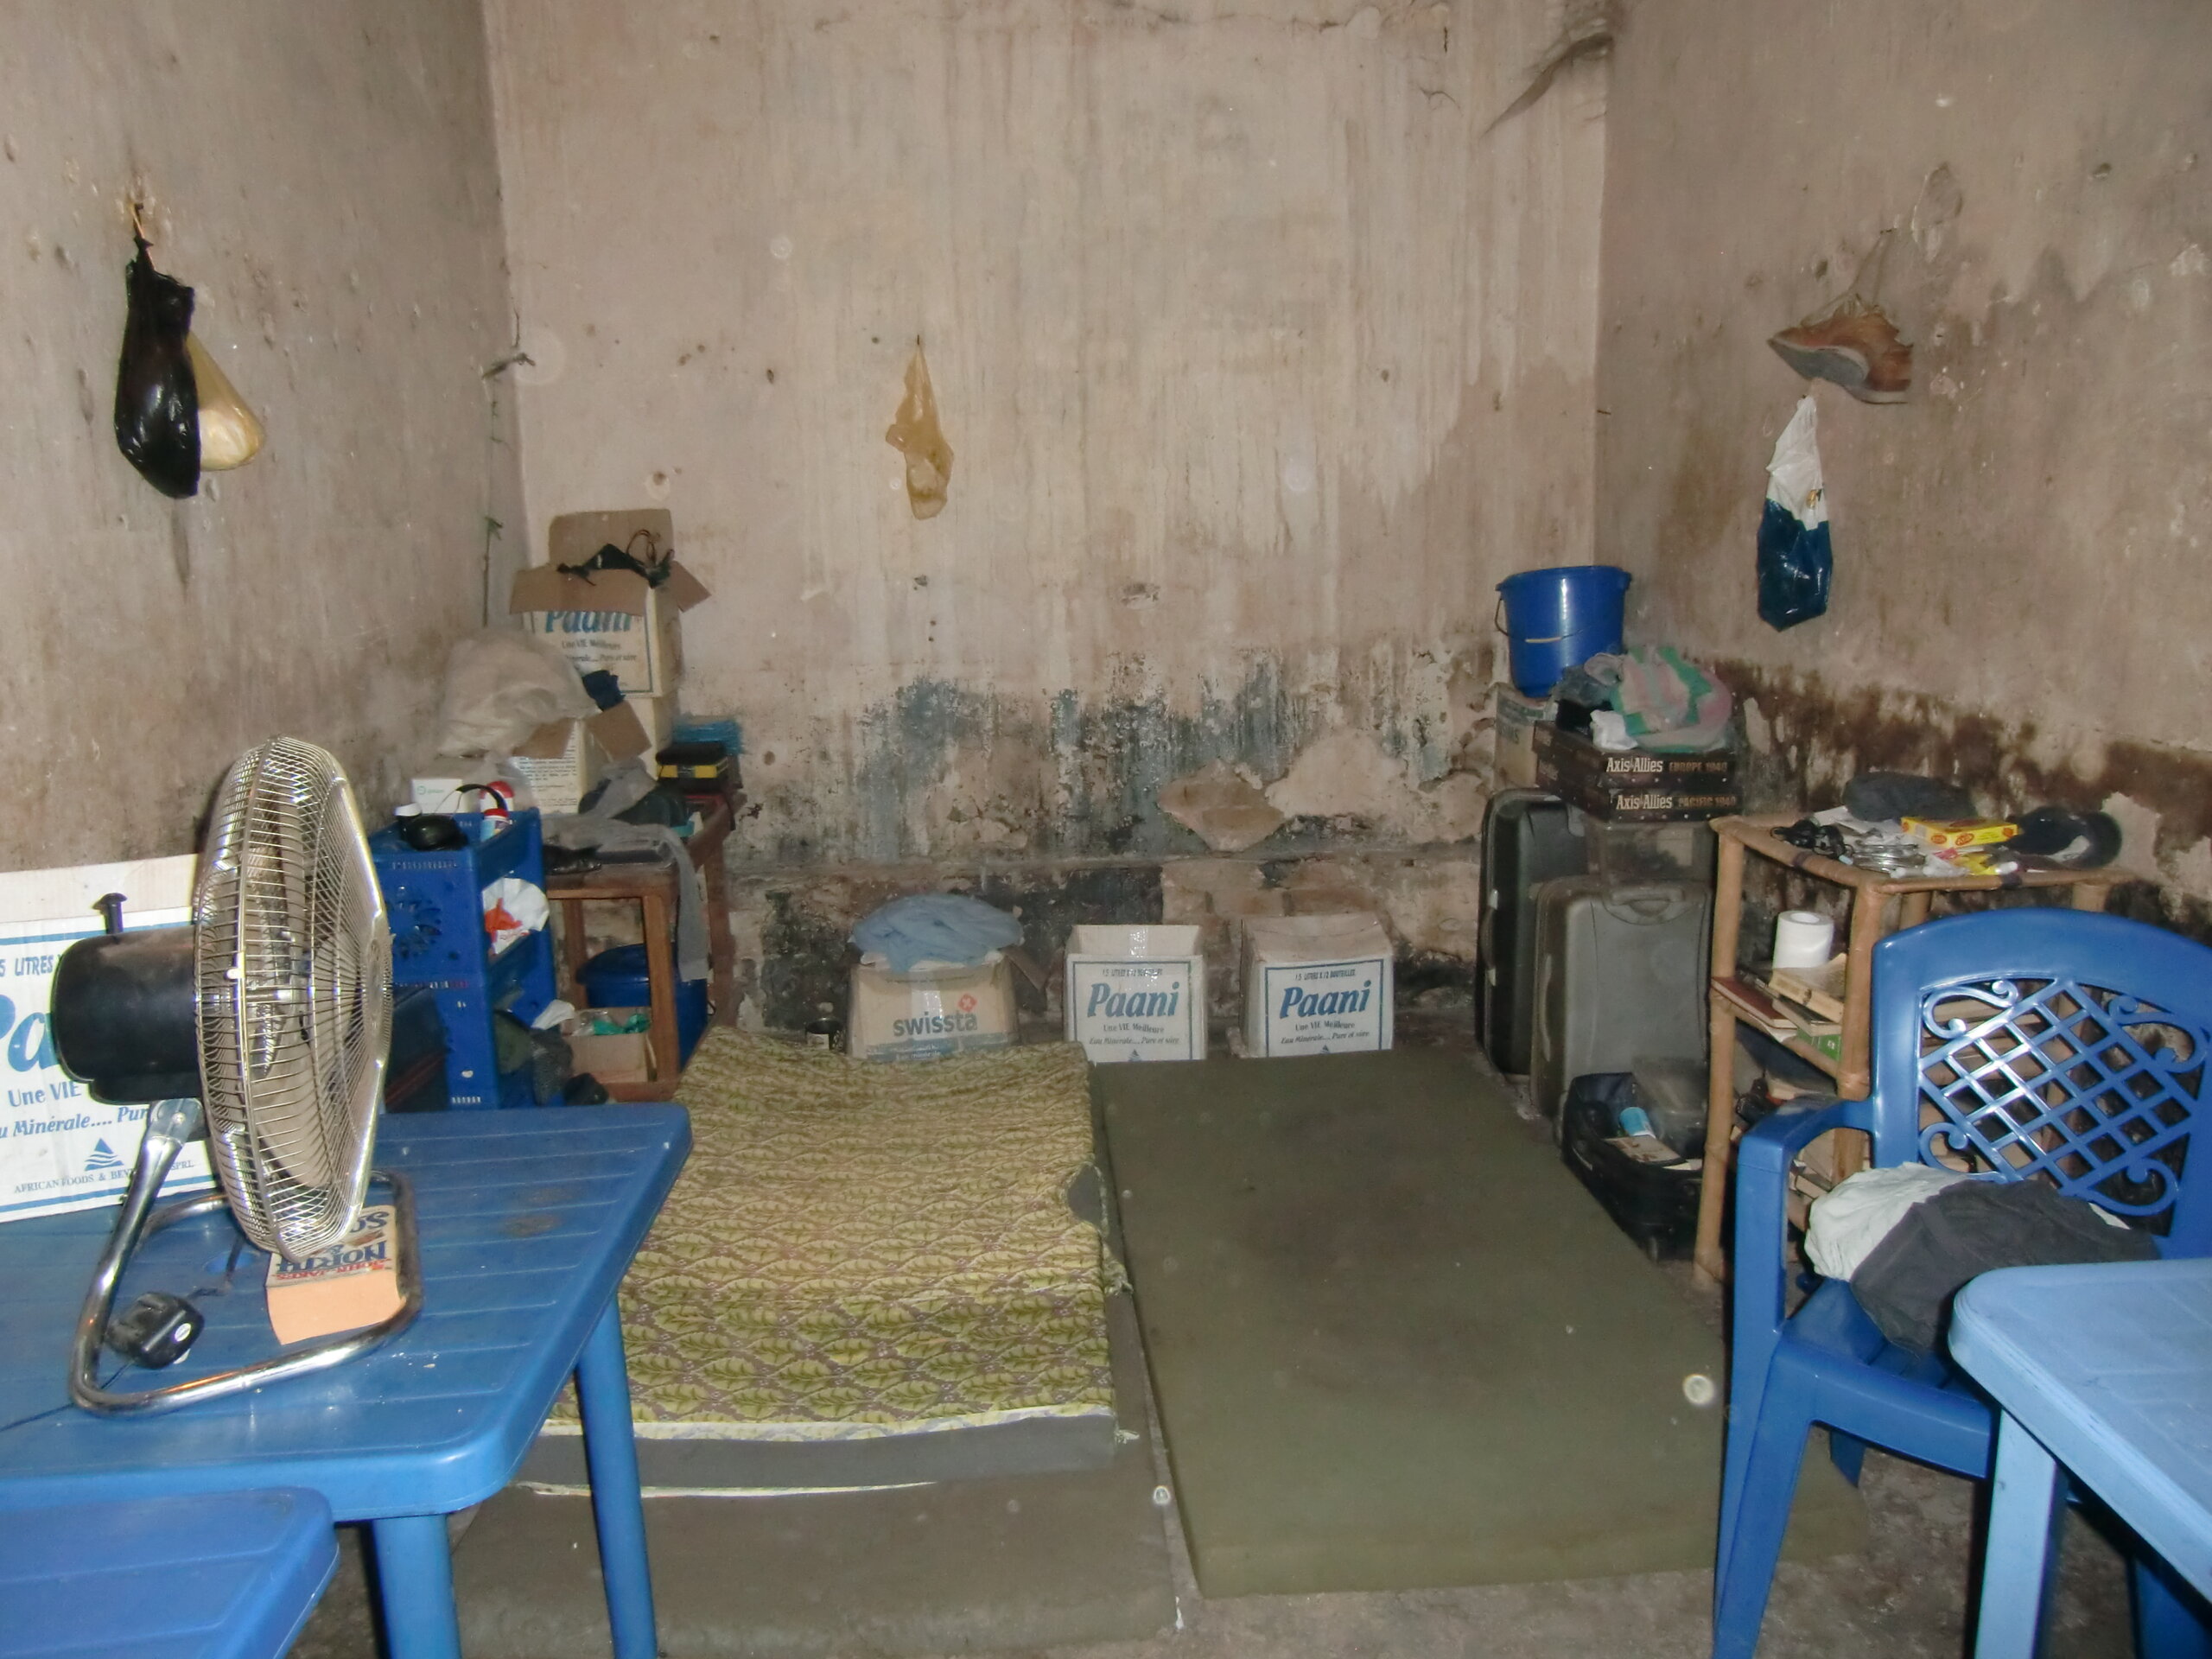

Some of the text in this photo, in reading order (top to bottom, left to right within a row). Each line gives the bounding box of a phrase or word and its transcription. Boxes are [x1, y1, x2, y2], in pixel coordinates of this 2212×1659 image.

[1606, 757, 1630, 772] Axis
[1633, 757, 1663, 772] Allies
[1669, 761, 1702, 772] EUROPE
[1616, 794, 1640, 810] Axis
[1643, 794, 1673, 810] Allies
[1678, 796, 1713, 808] PACIFIC
[15, 955, 54, 976] LITRES
[1087, 982, 1180, 1018] Paani
[1279, 980, 1372, 1020] Paani
[893, 1011, 978, 1037] swissta
[8, 1081, 81, 1107] Une VIE
[117, 1106, 149, 1122] Pur
[14, 1178, 60, 1194] AFRICAN
[61, 1174, 94, 1187] FOODS
[99, 1173, 106, 1181] &
[276, 1241, 388, 1273] NORTH
